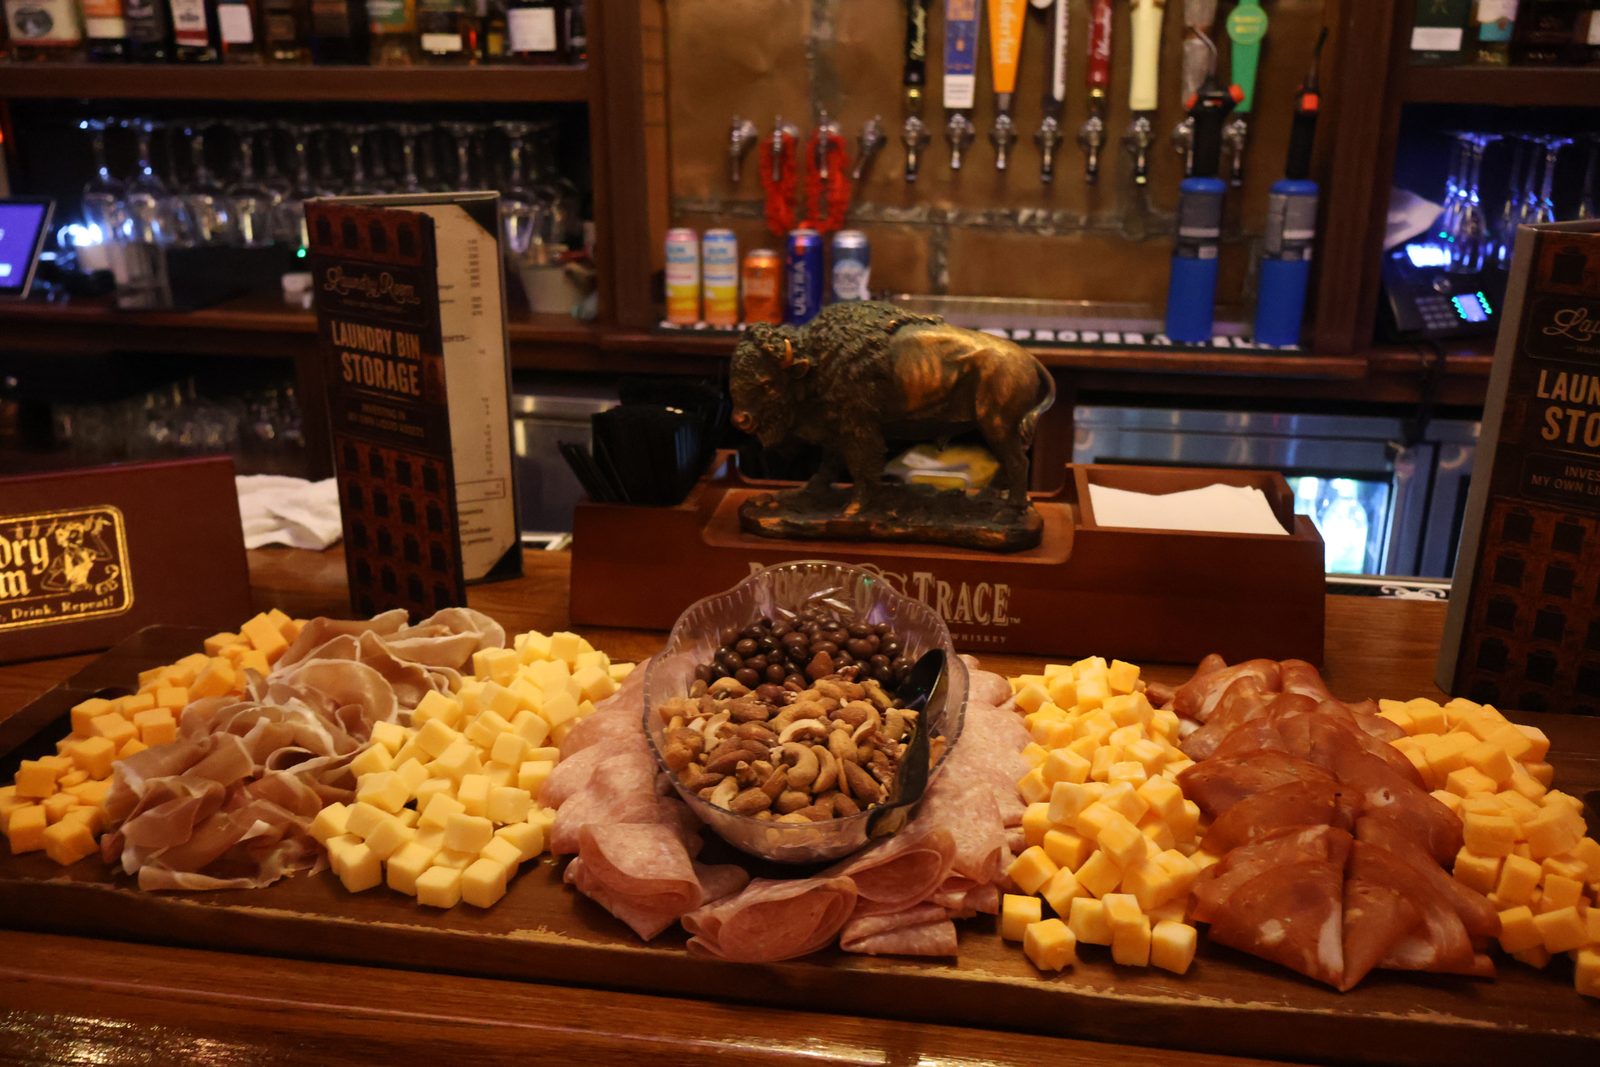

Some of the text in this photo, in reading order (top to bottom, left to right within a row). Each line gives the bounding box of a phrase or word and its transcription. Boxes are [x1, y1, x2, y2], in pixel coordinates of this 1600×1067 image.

[330, 319, 421, 359] LAUNDRY BIN
[341, 351, 421, 395] STORAGE
[1531, 473, 1552, 487] MY
[1554, 478, 1584, 494] OWN
[61, 594, 115, 613] Repeat!
[912, 571, 1011, 626] TRACE
